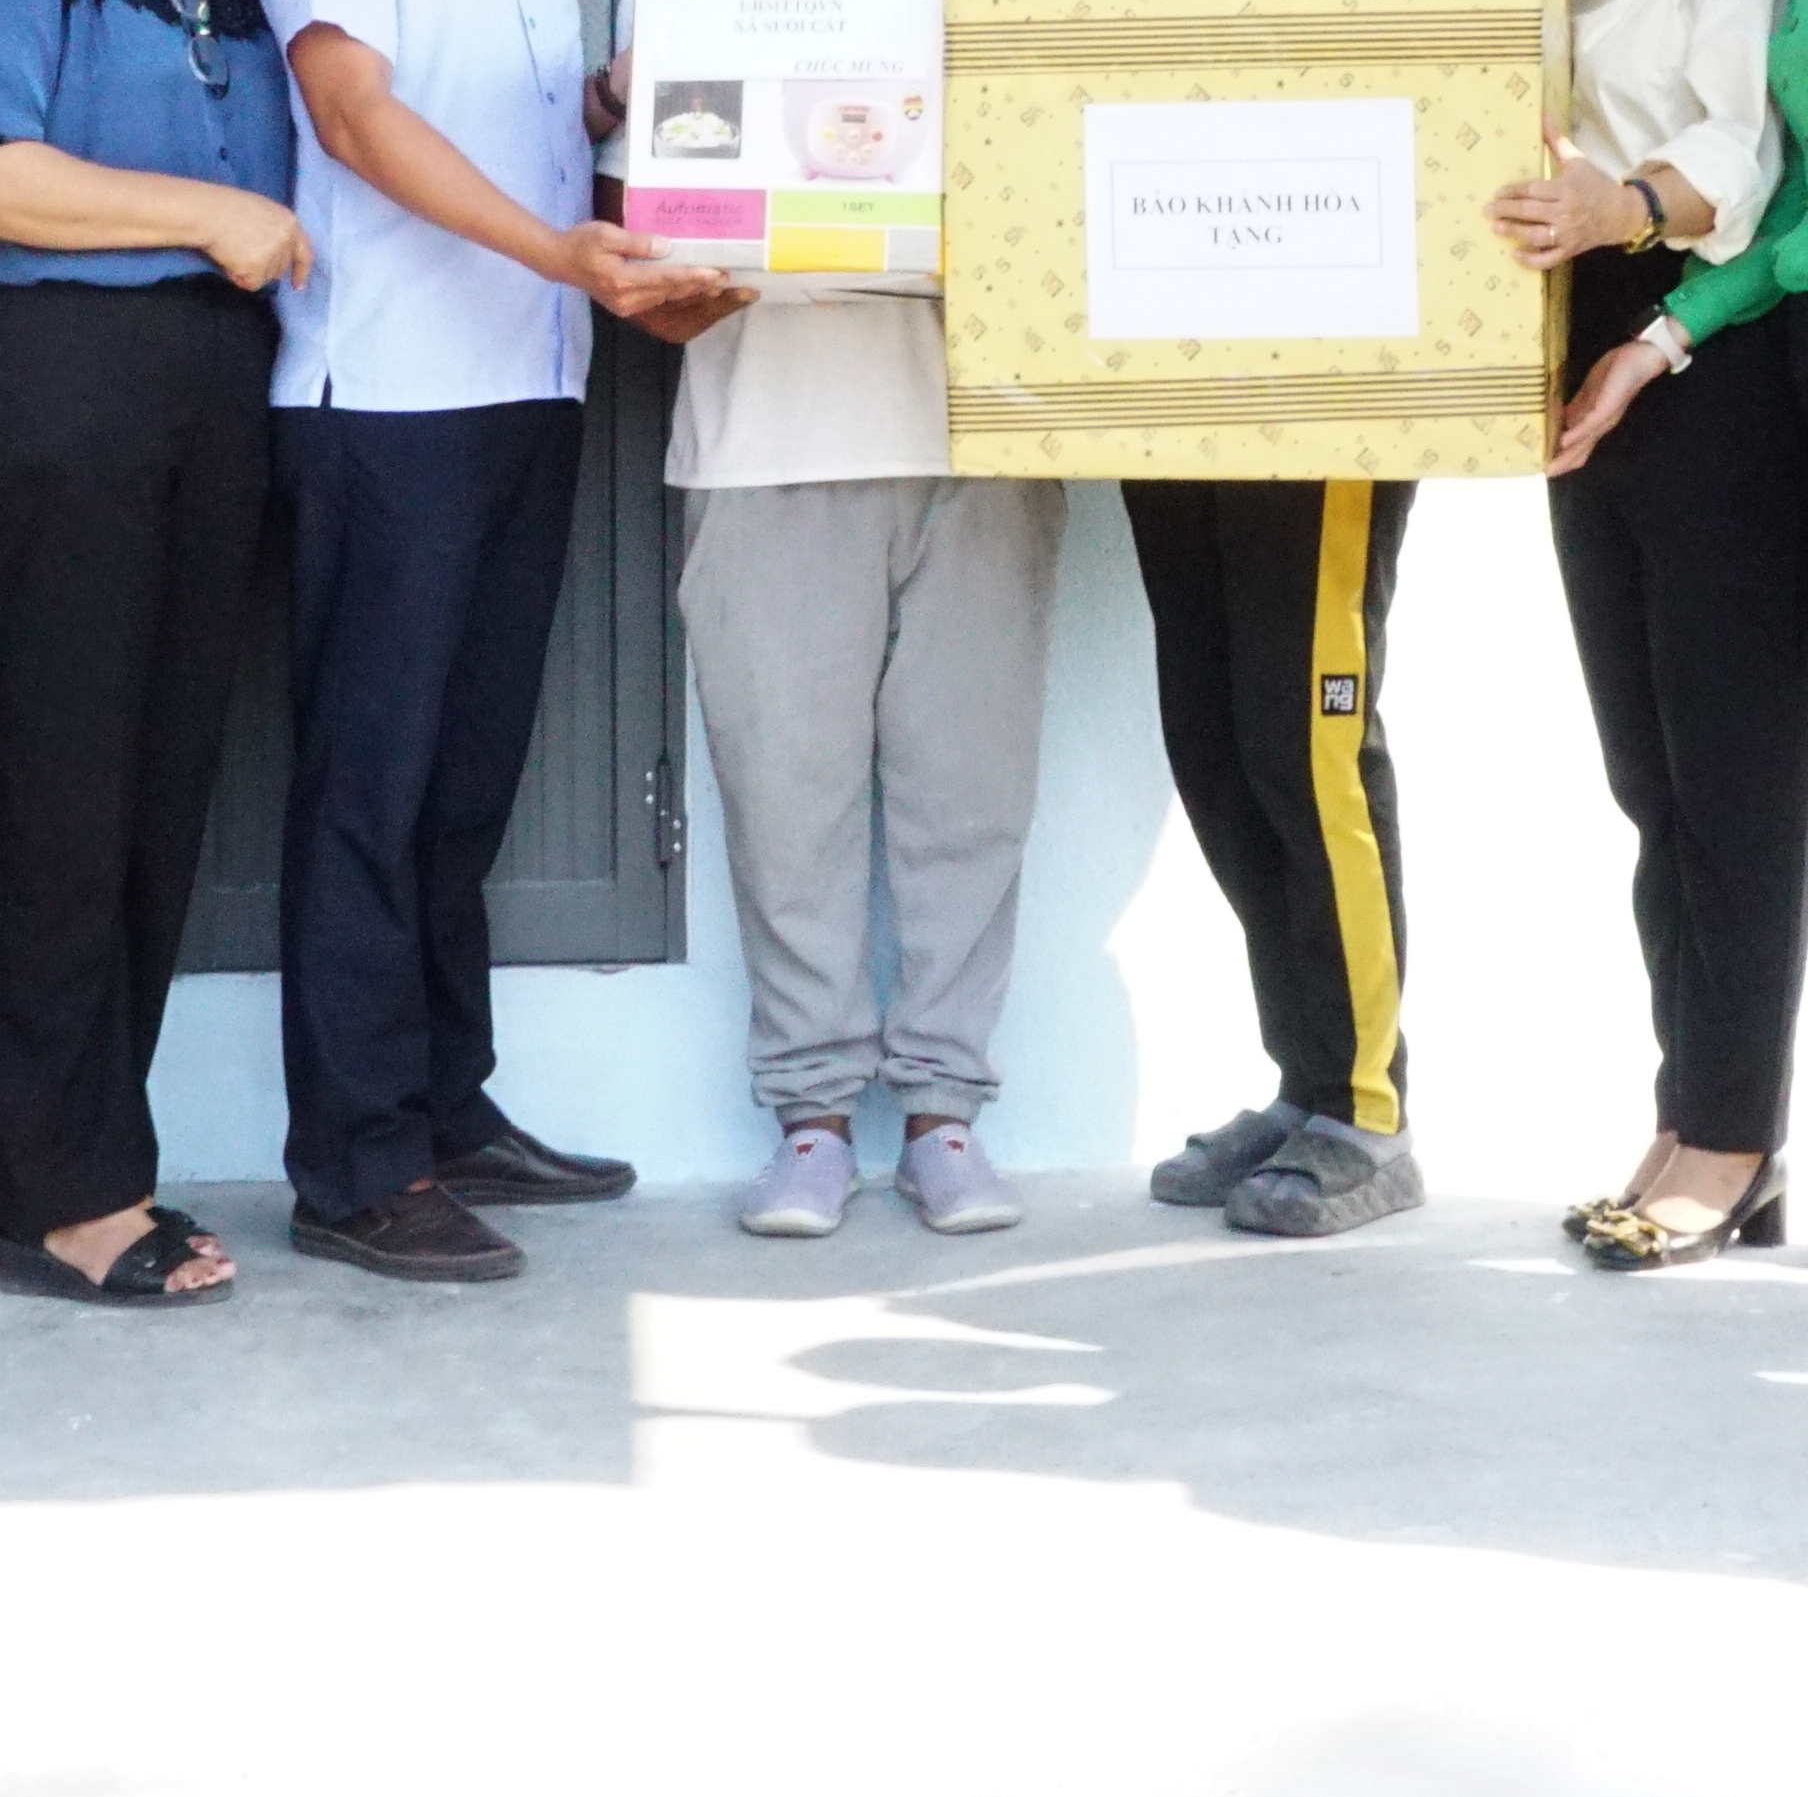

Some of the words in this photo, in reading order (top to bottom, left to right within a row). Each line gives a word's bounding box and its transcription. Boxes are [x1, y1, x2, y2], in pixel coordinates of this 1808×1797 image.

[1132, 189, 1187, 215] BÁO
[1196, 188, 1293, 214] KHÁNH
[1304, 186, 1362, 213] HÒA
[1207, 224, 1284, 250] TẶNG
